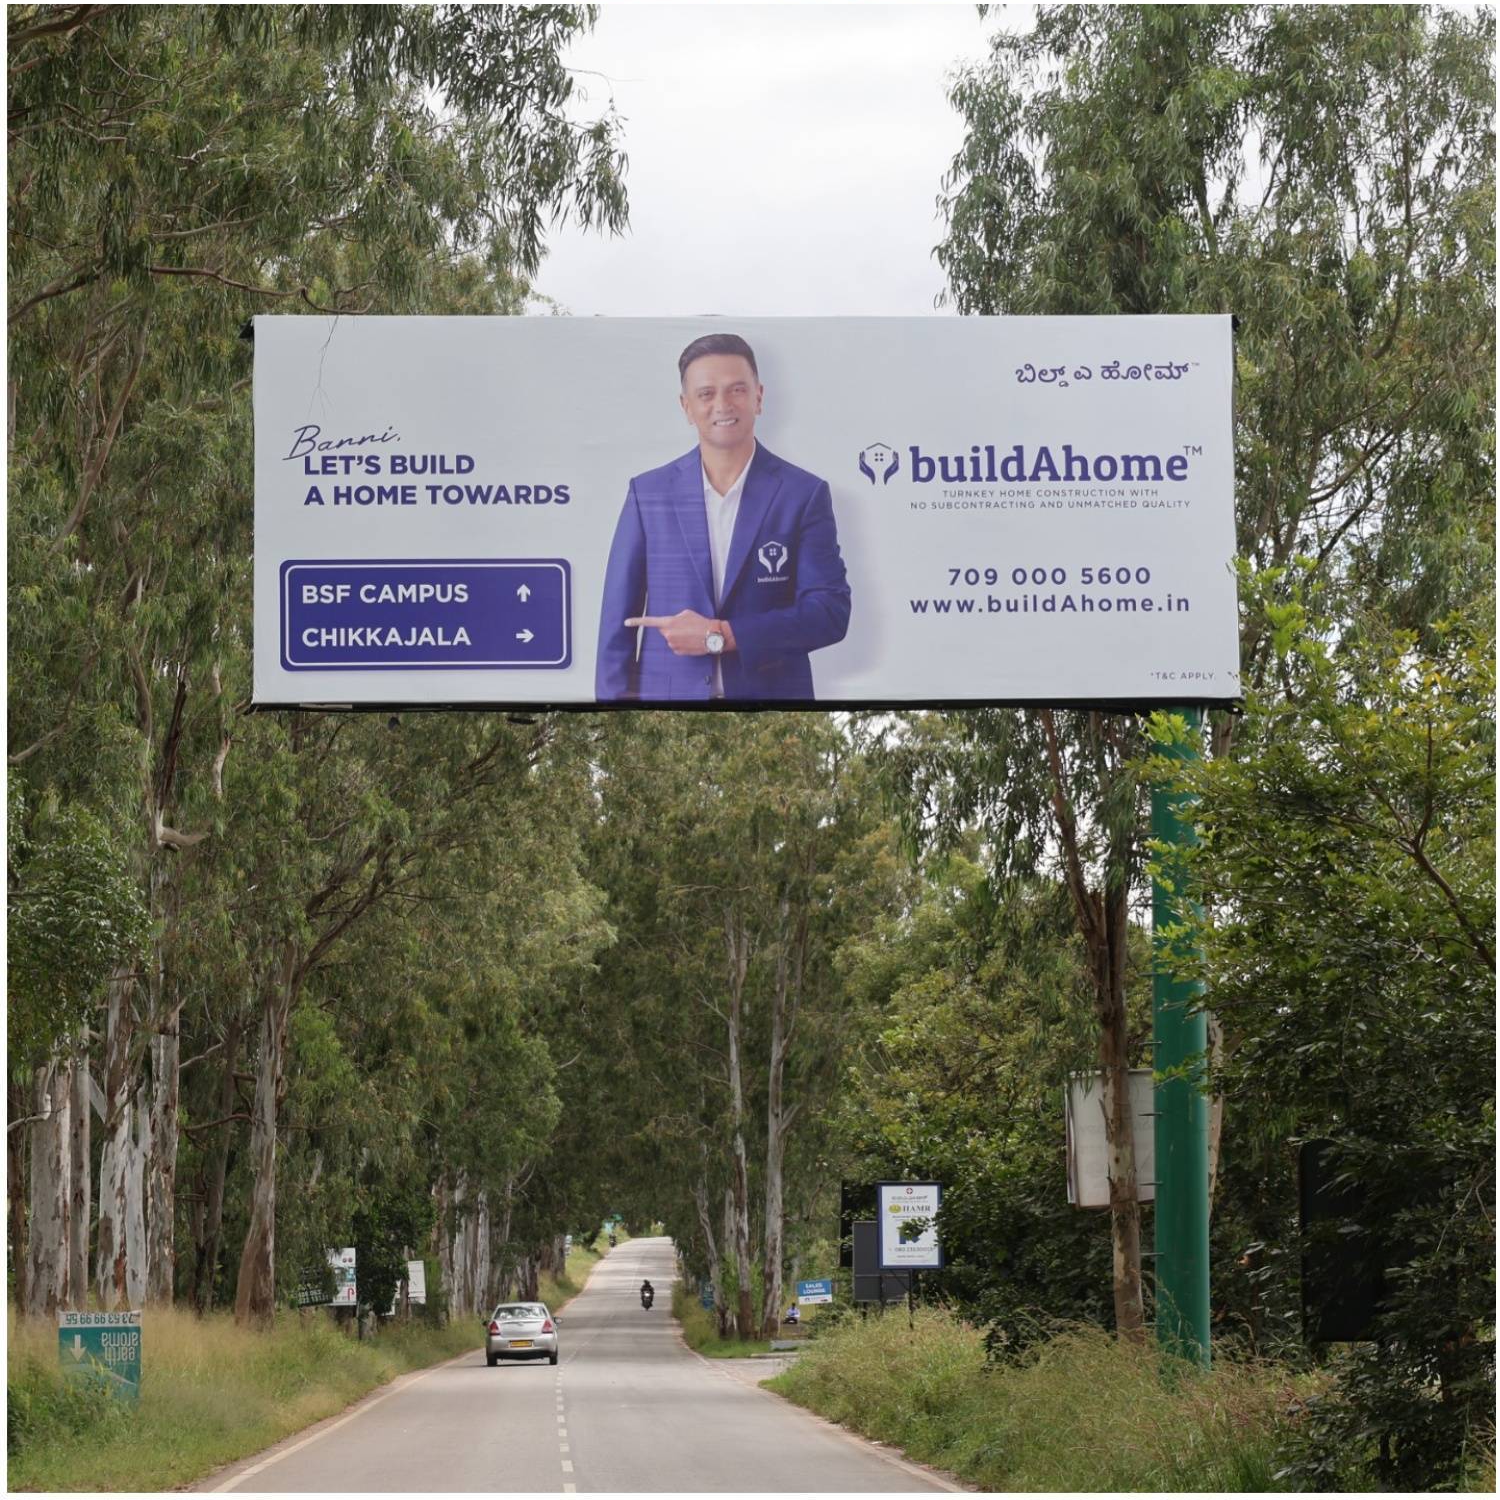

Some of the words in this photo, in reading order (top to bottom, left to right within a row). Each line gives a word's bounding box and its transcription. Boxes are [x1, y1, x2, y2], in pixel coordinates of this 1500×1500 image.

[1073, 364, 1093, 381] ಎ
[304, 455, 381, 476] LET’S
[390, 455, 475, 475] BUILD
[303, 485, 325, 506] A
[333, 485, 417, 506] HOME
[425, 484, 570, 505] TOWARDS
[942, 490, 995, 498] TURNKEY
[1000, 490, 1033, 498] HOME
[1036, 489, 1126, 498] CONSTRUCTION
[1130, 489, 1158, 497] WITH
[910, 501, 927, 510] NO
[931, 501, 1036, 510] SUBCONTRACTING
[1040, 501, 1063, 509] AND
[1067, 500, 1138, 509] UNMATCHED
[1142, 500, 1191, 509] QUALITY
[948, 568, 998, 586] 709
[1012, 568, 1067, 586] 000
[1081, 567, 1152, 585] 5600
[302, 584, 351, 604] BSF
[359, 583, 469, 604] CAMPUS
[910, 594, 1190, 614] www.buildAhome.in
[301, 627, 472, 648] CHIKKAJALA
